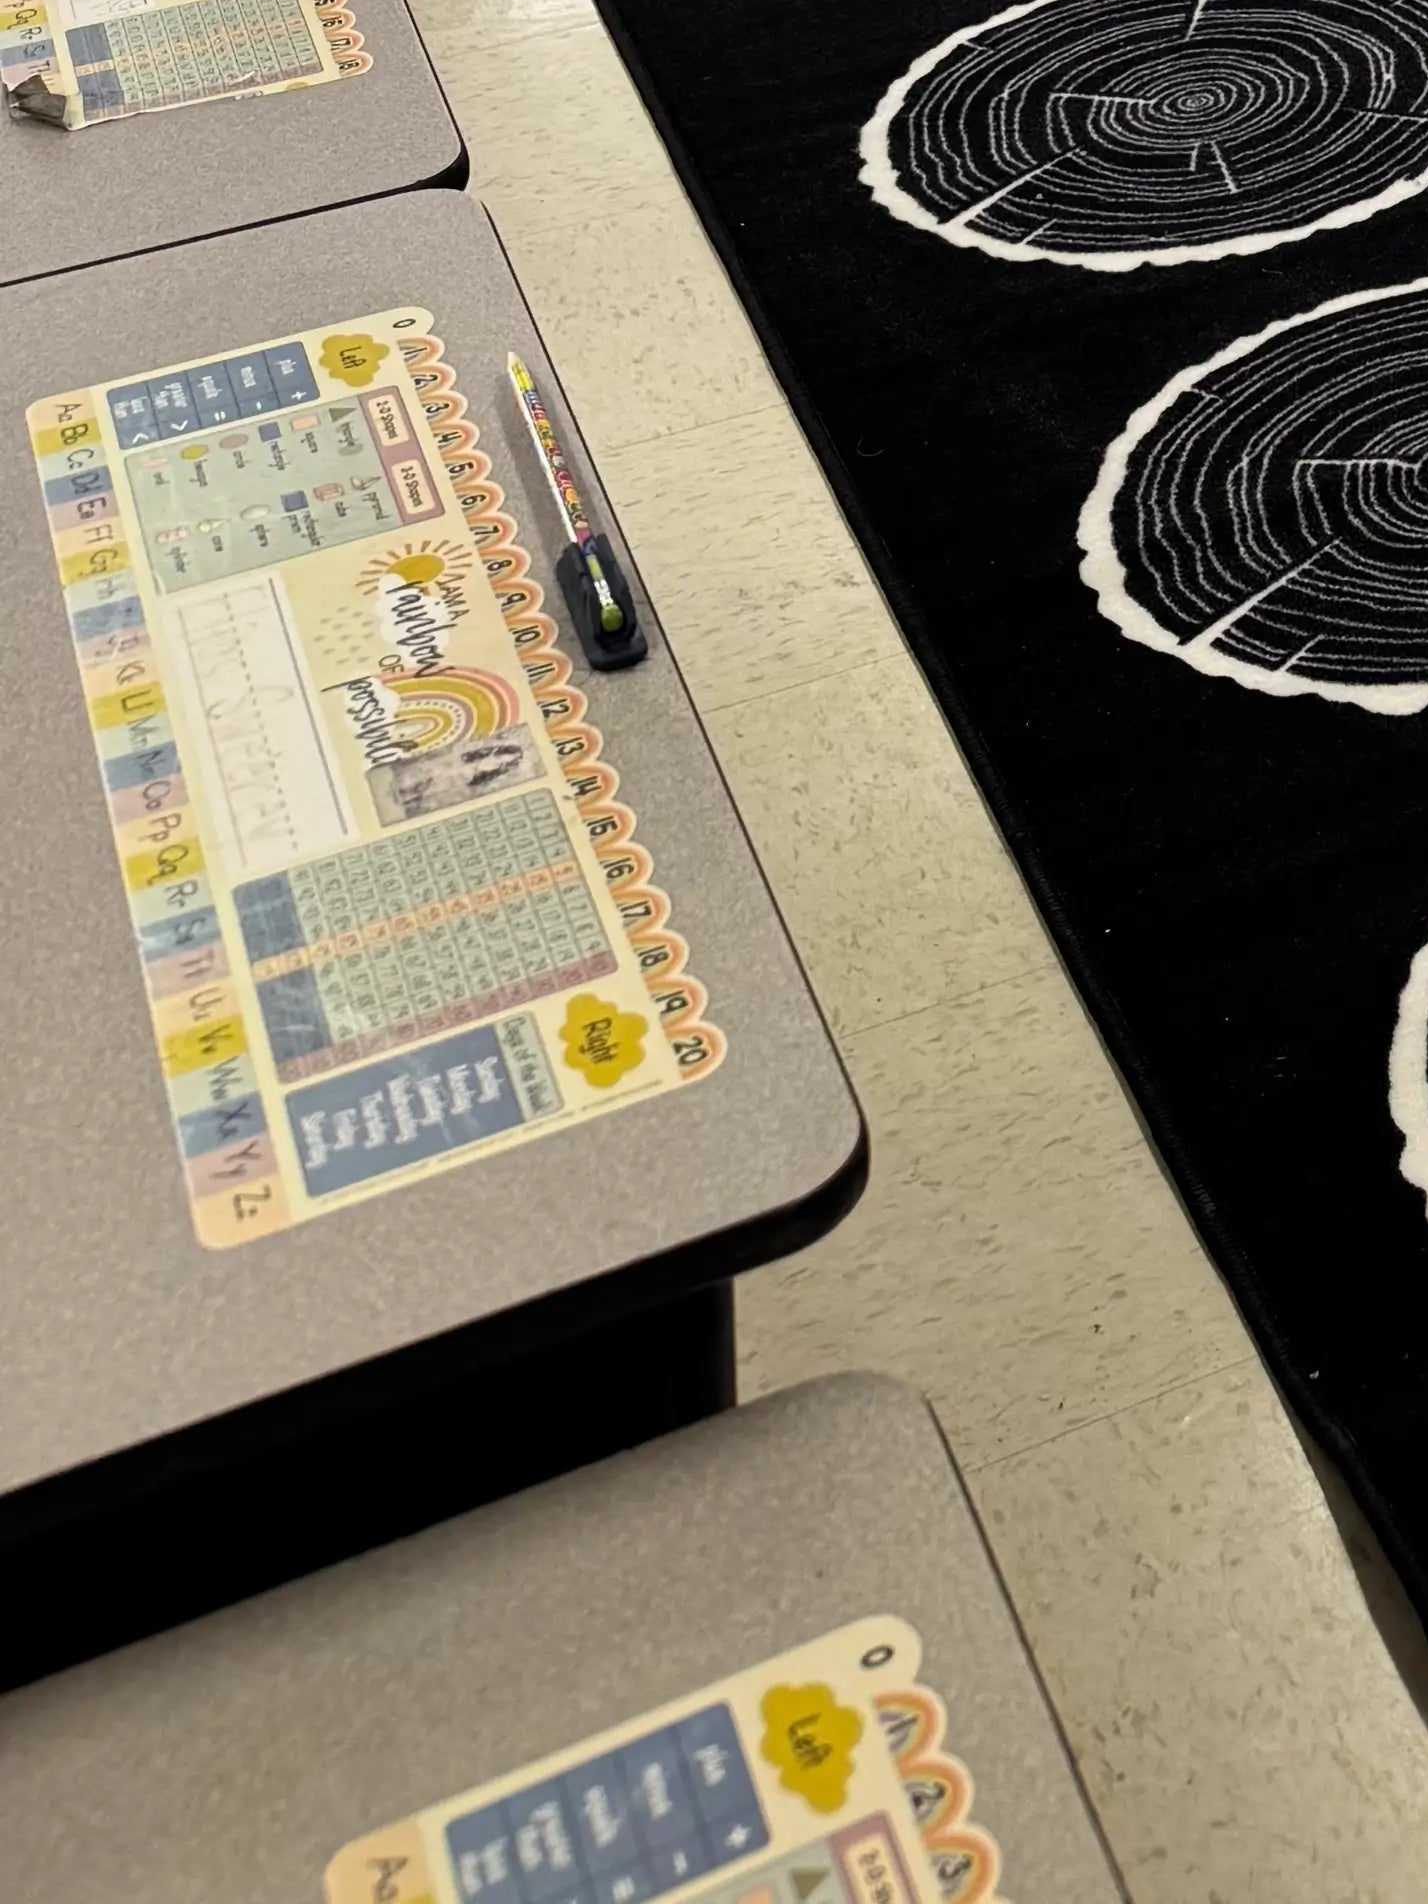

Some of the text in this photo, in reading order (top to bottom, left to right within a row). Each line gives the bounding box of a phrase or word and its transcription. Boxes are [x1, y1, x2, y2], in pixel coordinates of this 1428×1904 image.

[385, 580, 458, 679] rainbow
[378, 654, 404, 674] OF
[578, 1017, 619, 1065] Right
[673, 1036, 707, 1067] 20
